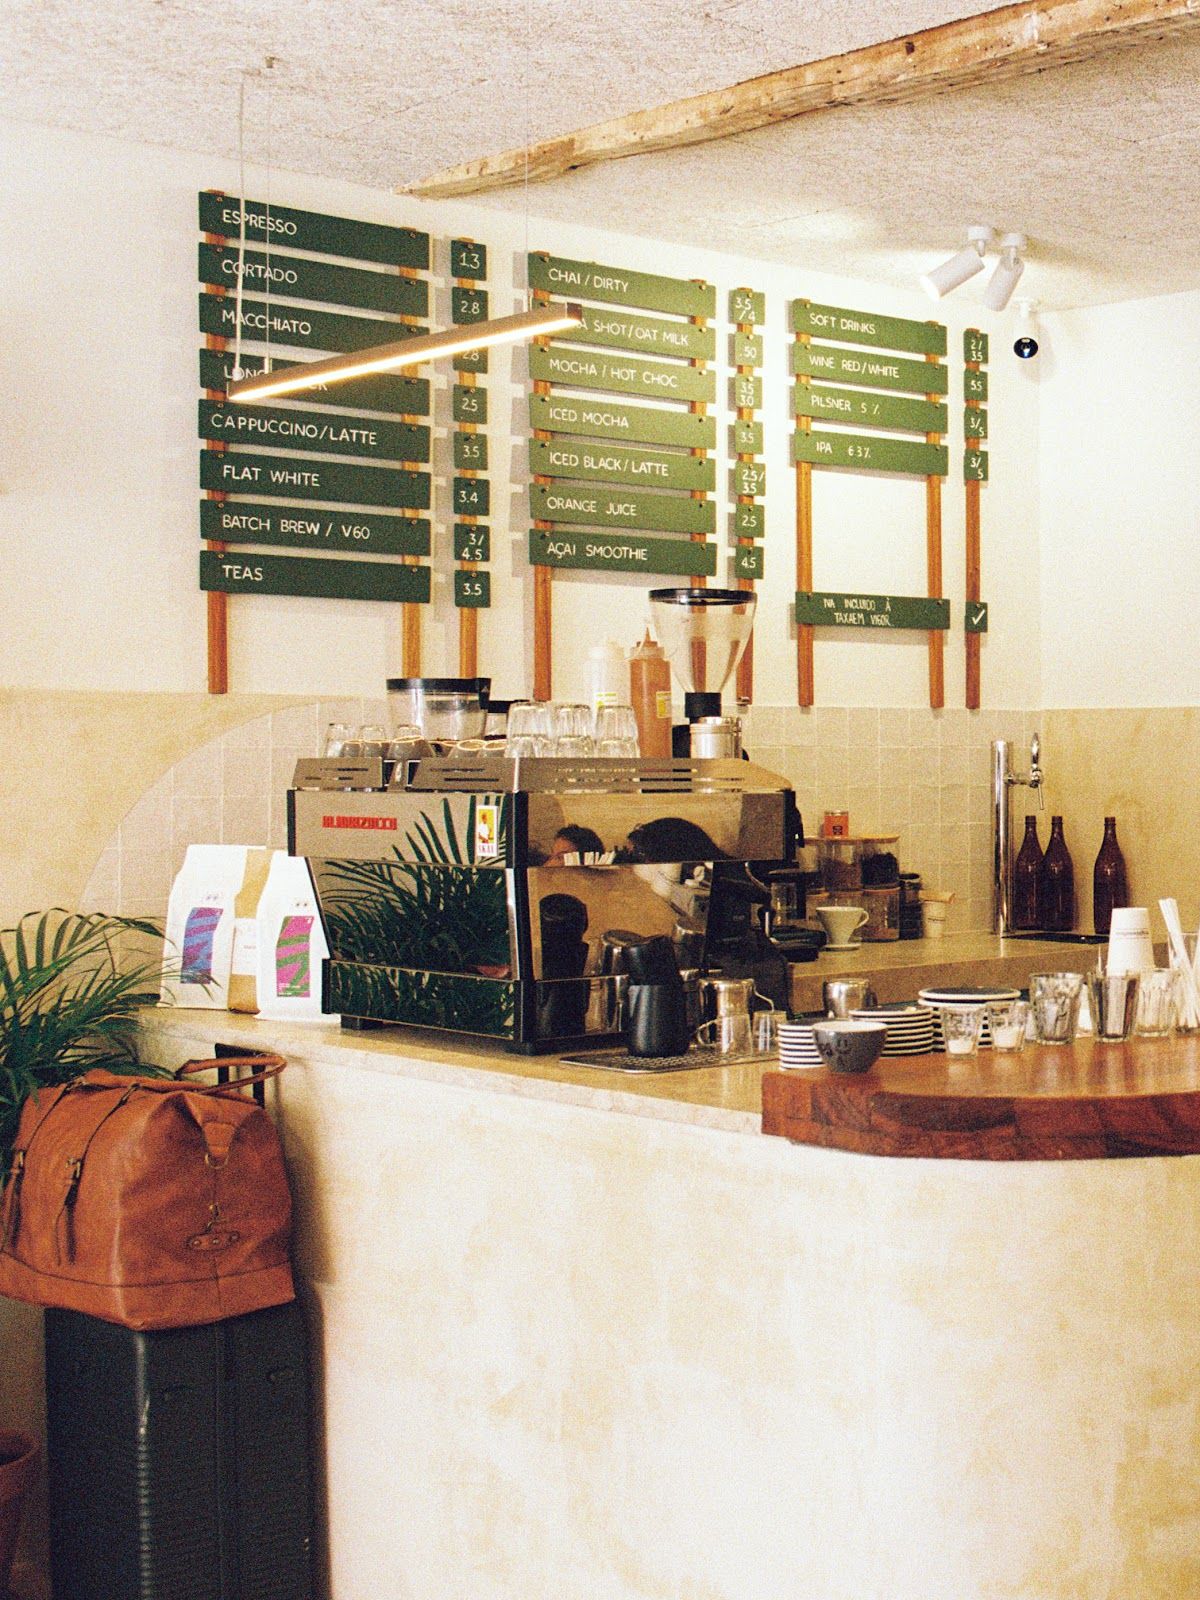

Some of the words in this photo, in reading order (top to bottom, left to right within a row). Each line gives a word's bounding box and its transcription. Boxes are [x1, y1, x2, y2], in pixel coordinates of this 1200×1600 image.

[222, 209, 297, 236] ESPRESSO
[222, 259, 297, 284] CORTADO
[549, 268, 581, 284] CHAI
[584, 275, 590, 286] /
[593, 276, 629, 293] DIRTY
[460, 301, 480, 315] 2.8
[222, 309, 311, 335] MACCHIATO
[809, 313, 836, 328] SOFT
[840, 318, 876, 335] DRINKS
[662, 331, 689, 346] MILK
[809, 356, 836, 369] WINE
[550, 359, 598, 376] MOCHA
[611, 367, 637, 381] HOT
[642, 371, 678, 388] CHOC
[811, 395, 852, 411] PILSNER
[550, 408, 577, 421] ICED
[582, 412, 629, 428] MOCHA
[211, 413, 377, 445] CAPPUCCINO/LATTE
[816, 441, 832, 454] IPA
[550, 452, 579, 467] ICED
[223, 464, 261, 481] FLAT
[270, 470, 321, 487] WHITE
[459, 491, 479, 504] 3.4
[547, 496, 597, 513] ORANGE
[605, 502, 637, 516] JUICE
[222, 514, 271, 532] BATCH
[280, 519, 320, 536] BREW
[325, 522, 333, 537] /
[341, 525, 371, 540] V60
[461, 548, 482, 560] 4.5
[547, 542, 576, 559] AÇAI
[585, 546, 648, 561] SMOOTHIE
[222, 565, 263, 581] TEAS
[463, 583, 482, 595] 3.5
